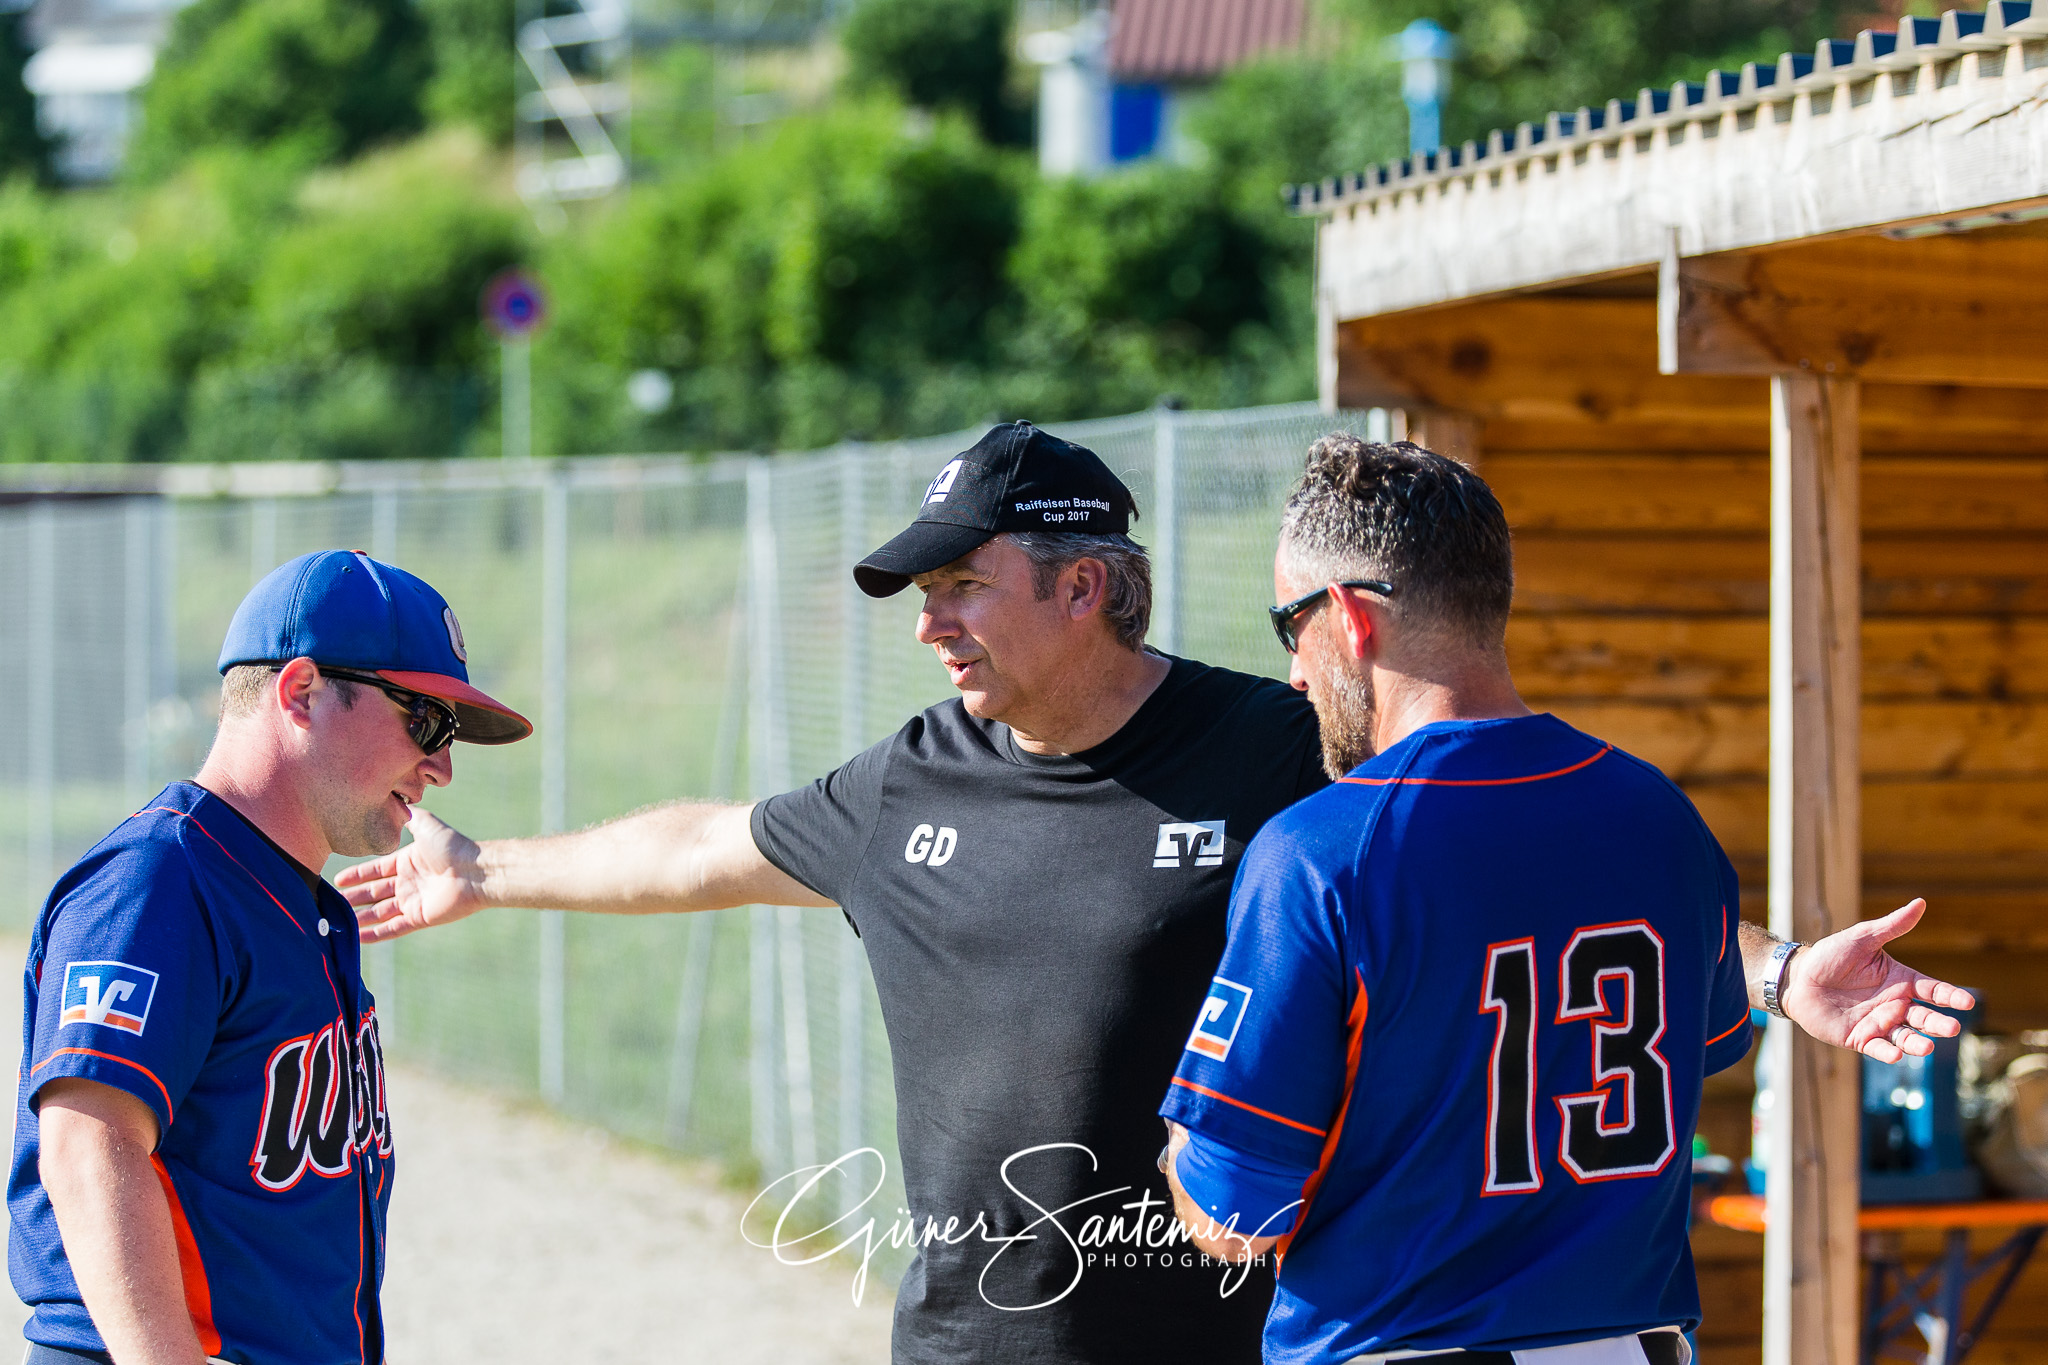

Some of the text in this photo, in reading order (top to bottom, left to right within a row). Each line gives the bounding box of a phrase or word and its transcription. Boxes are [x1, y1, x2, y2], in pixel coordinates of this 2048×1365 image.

[1015, 498, 1110, 512] Raiffeisen Baseball
[1043, 511, 1090, 524] Cup 2017
[904, 823, 958, 867] GD
[1478, 919, 1677, 1197] 13
